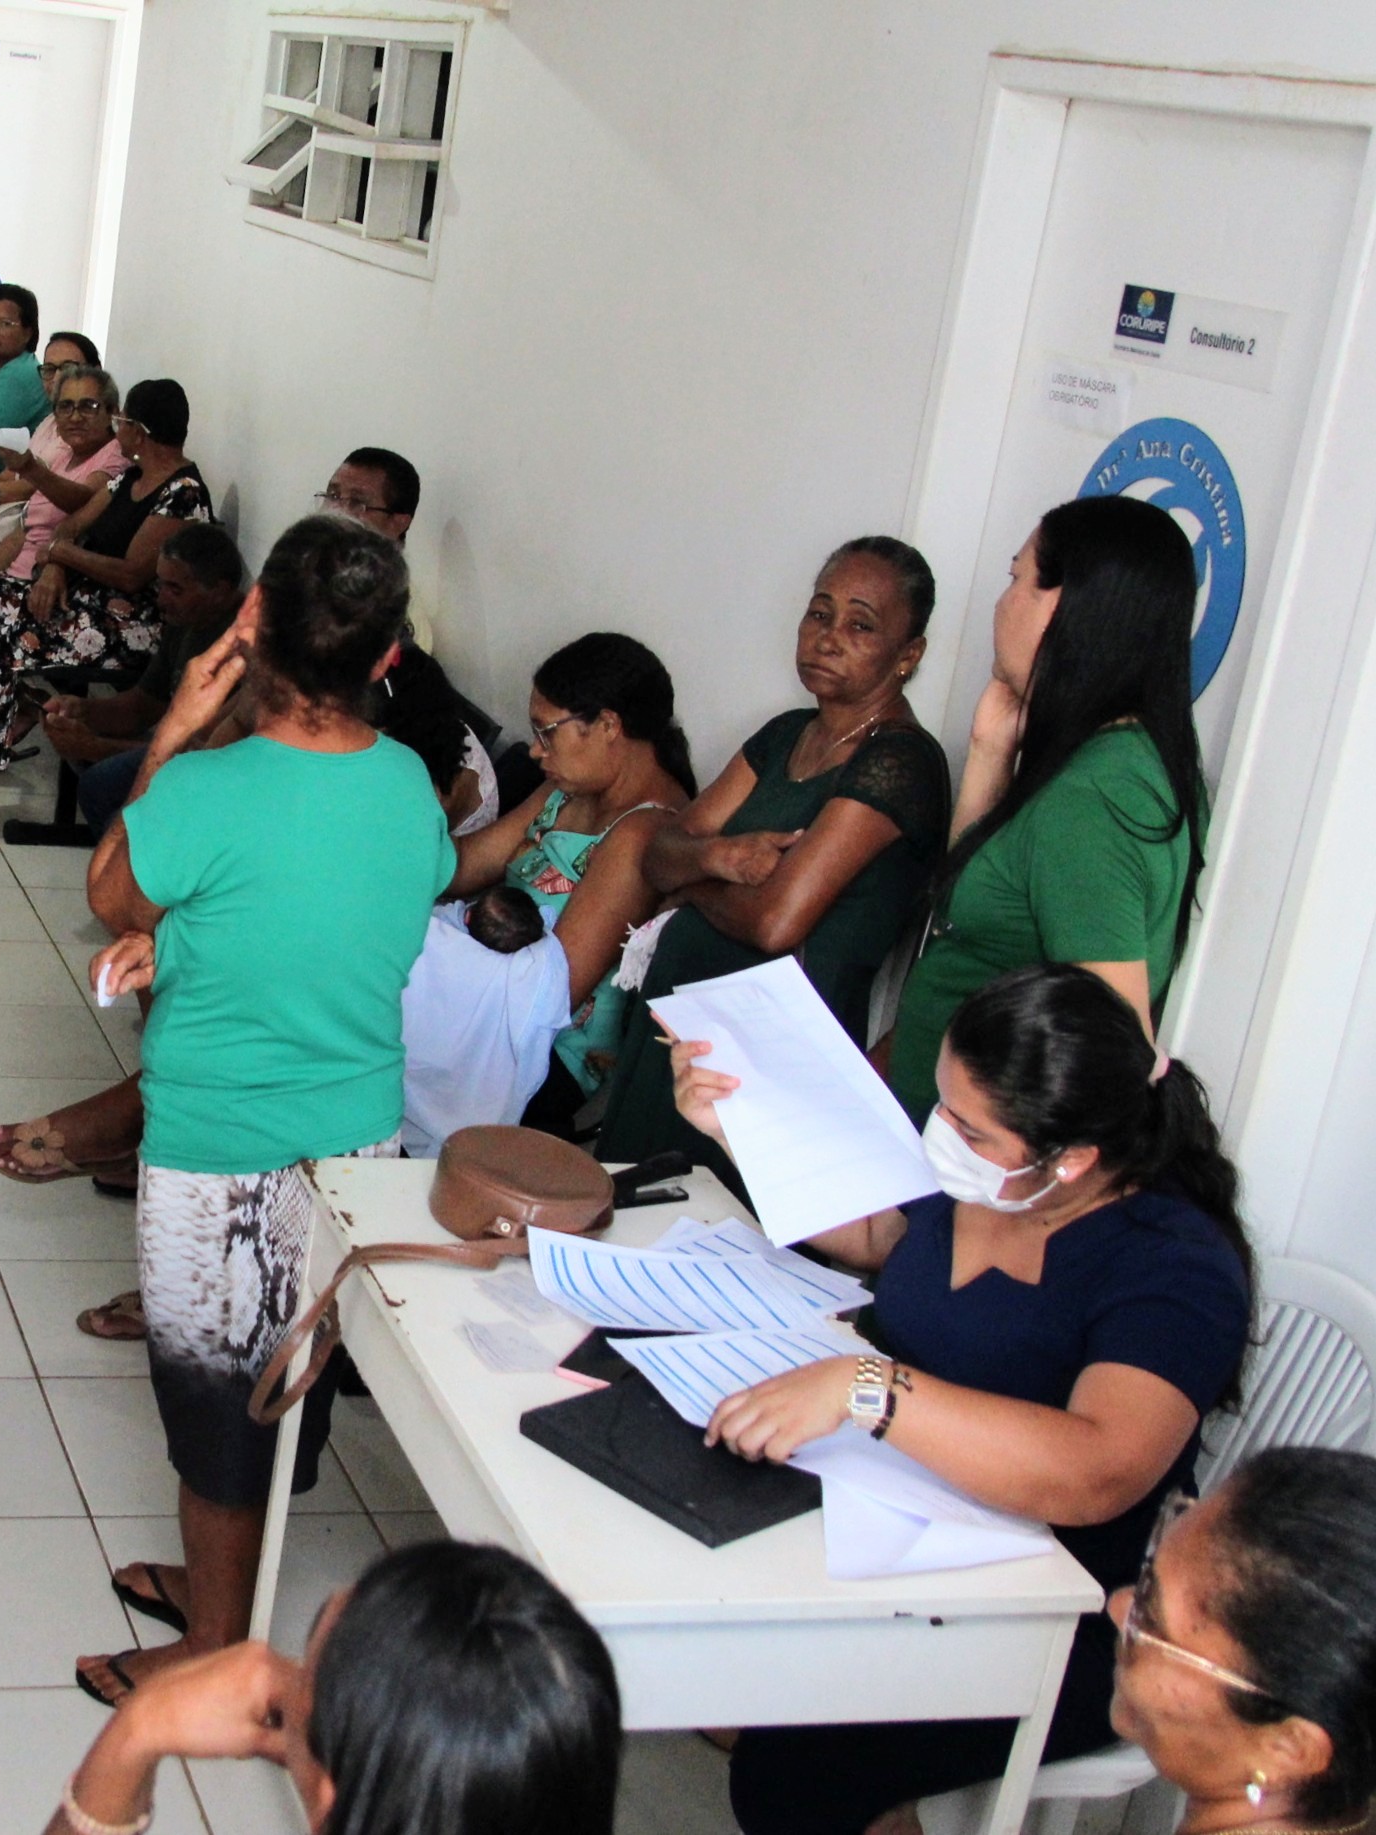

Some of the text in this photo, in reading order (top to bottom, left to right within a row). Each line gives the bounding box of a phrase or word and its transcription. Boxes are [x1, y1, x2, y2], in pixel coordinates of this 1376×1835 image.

[1119, 313, 1167, 335] CORURIPE
[1190, 327, 1256, 355] Consultório 2
[1079, 376, 1117, 395] MÁSCARA
[1135, 440, 1172, 461] Ana
[1180, 443, 1232, 548] Cristina
